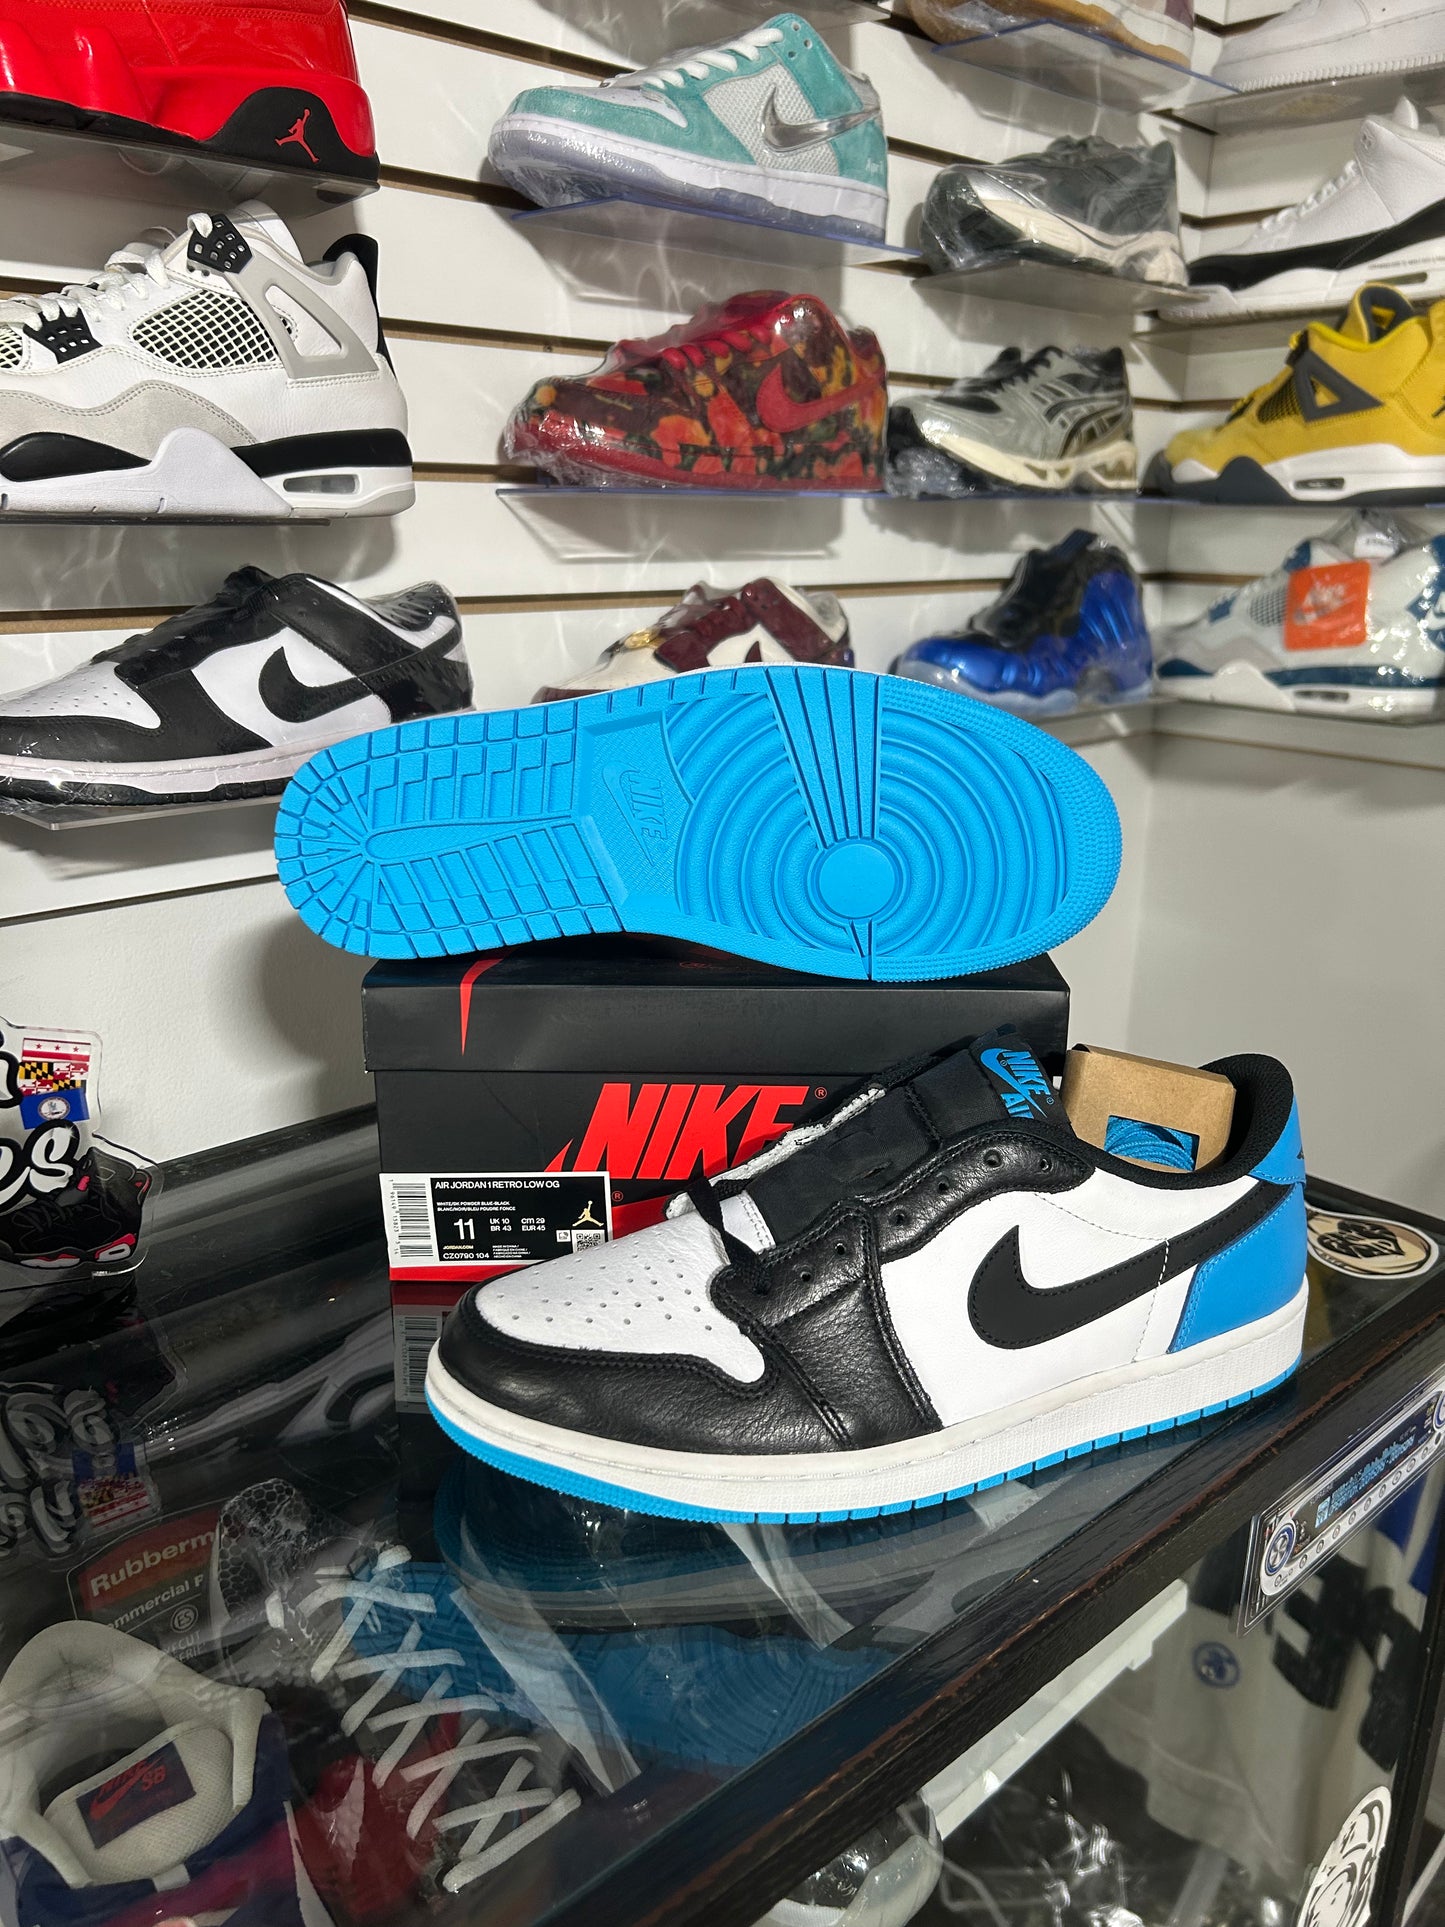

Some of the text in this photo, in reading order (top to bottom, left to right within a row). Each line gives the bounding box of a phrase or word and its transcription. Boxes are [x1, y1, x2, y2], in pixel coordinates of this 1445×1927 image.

[629, 775, 668, 841] NIKE
[1002, 1051, 1051, 1096] NIKE
[572, 1083, 809, 1180] NIKE
[434, 1181, 450, 1189] AIR
[450, 1181, 487, 1189] JORDAN
[492, 1181, 523, 1189] RETRO
[523, 1180, 545, 1189] LOW
[545, 1180, 560, 1188] OG
[453, 1218, 475, 1240] 11
